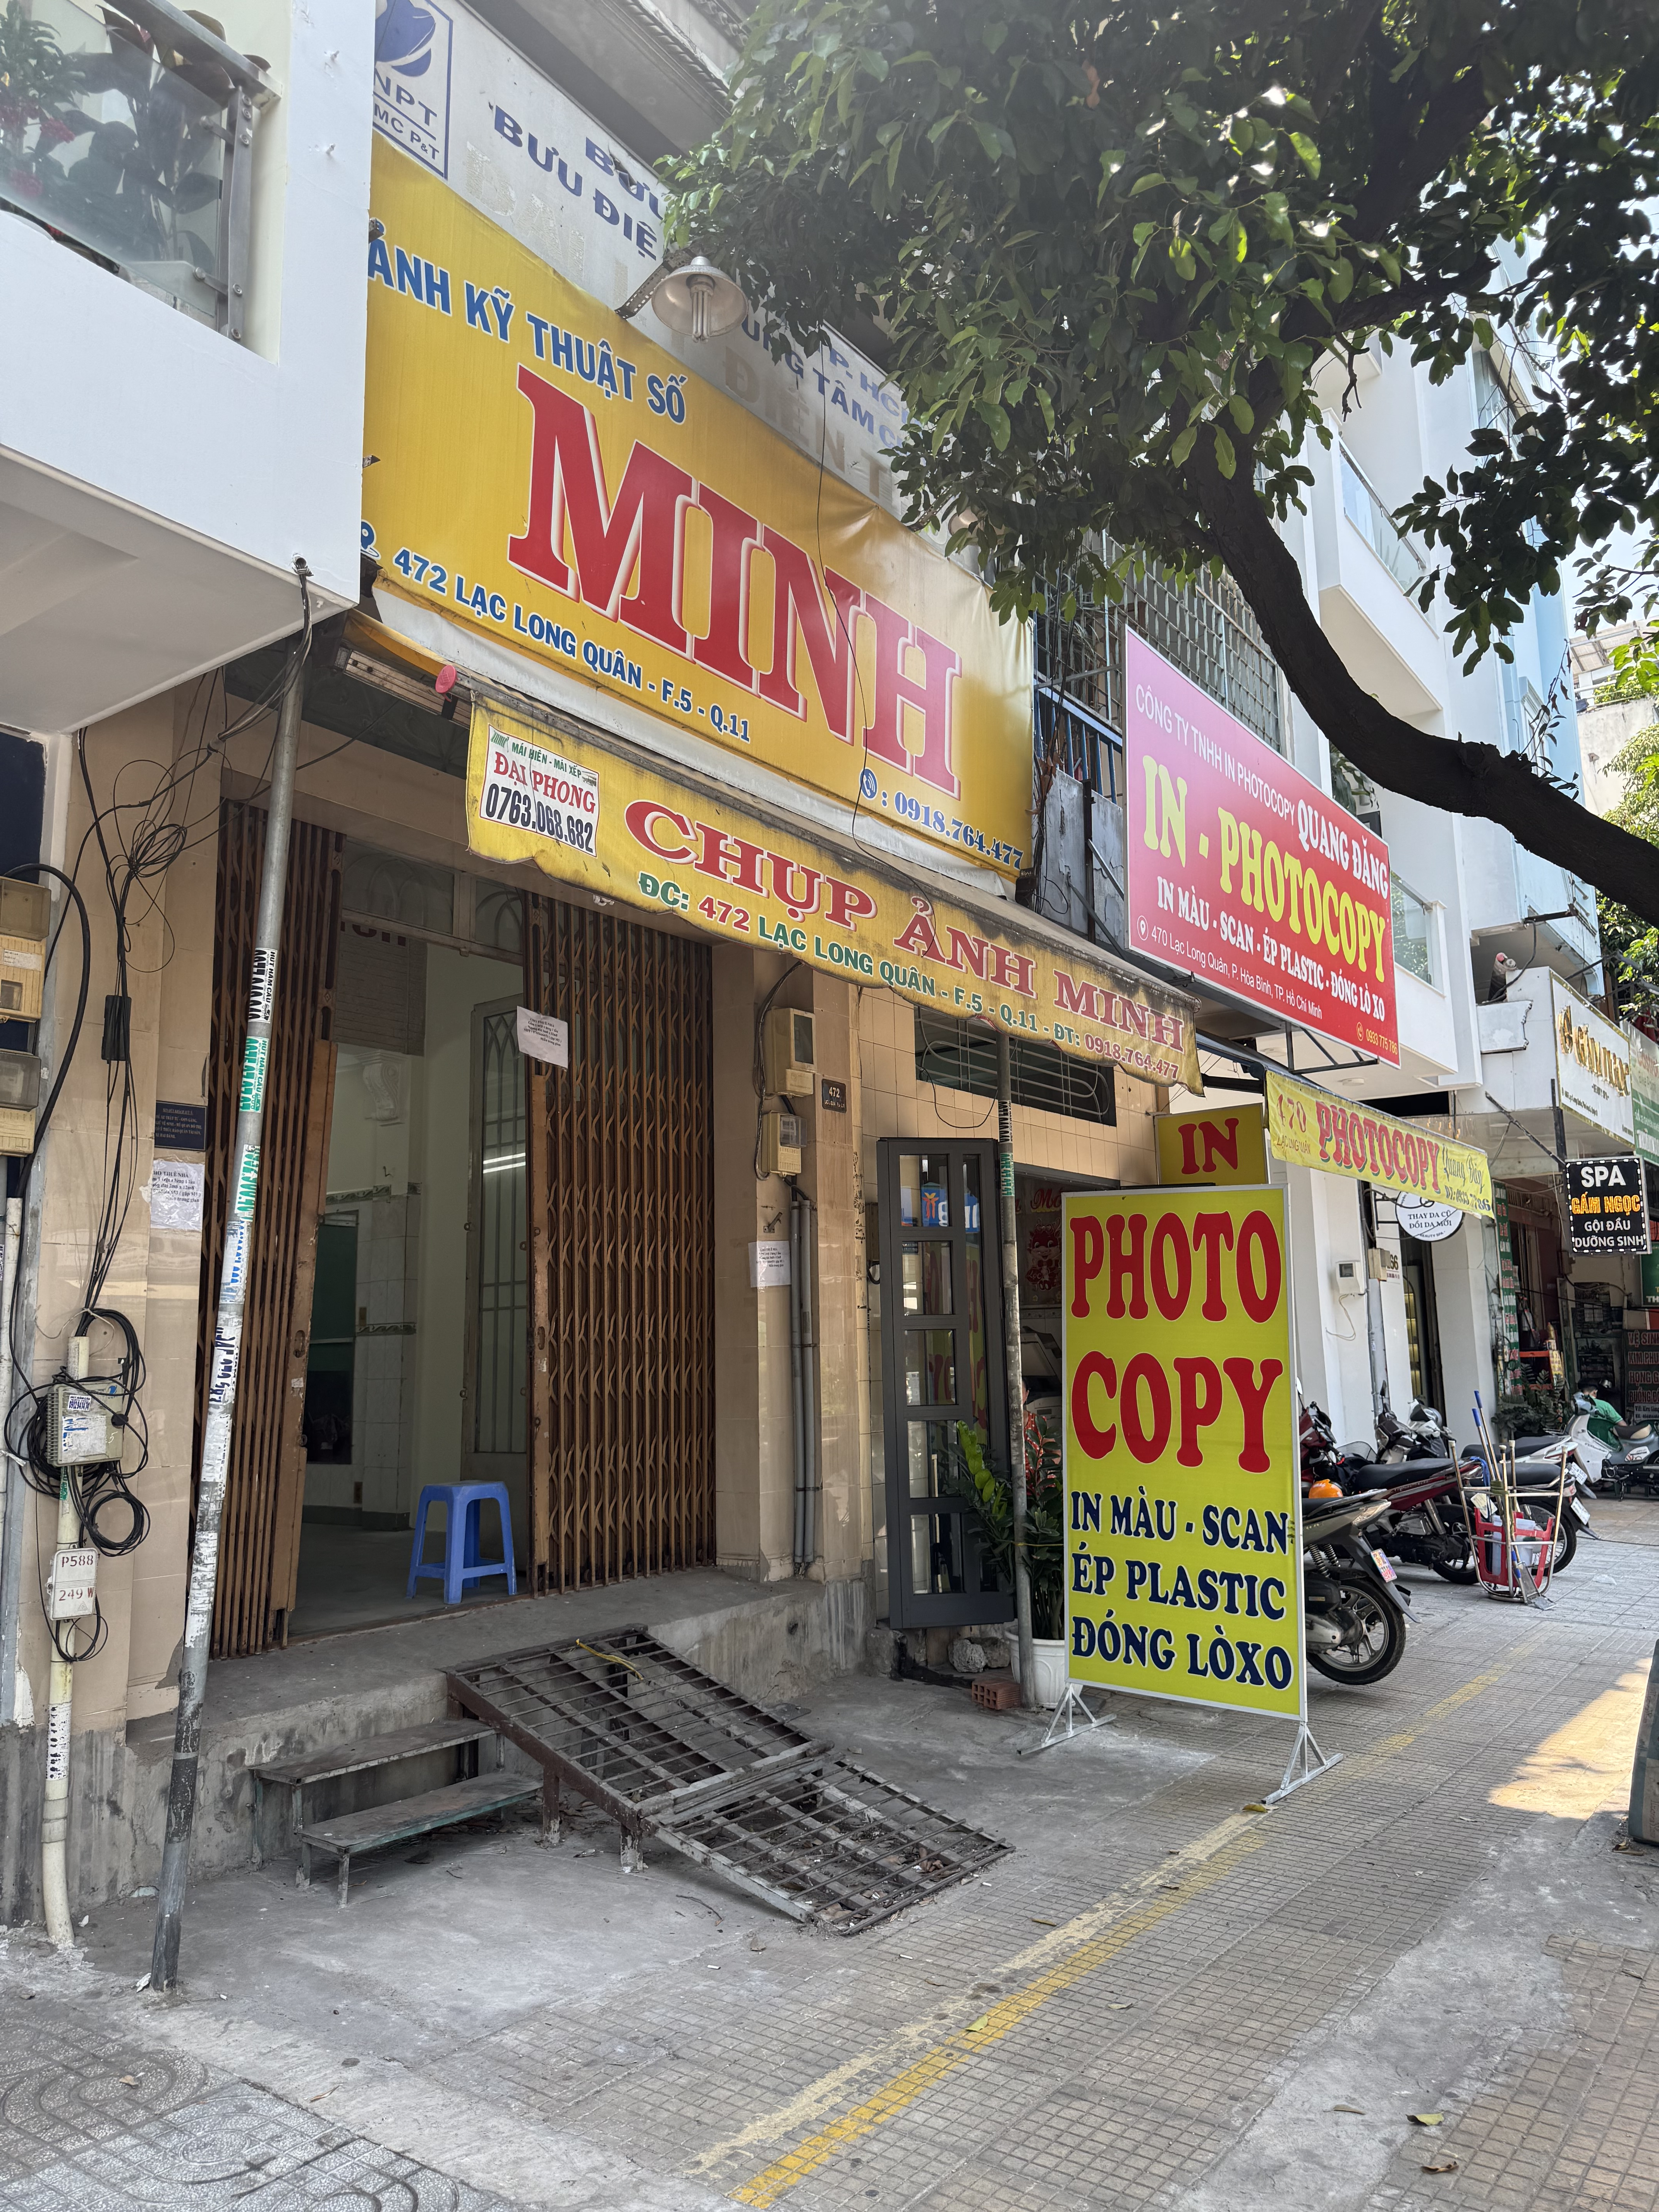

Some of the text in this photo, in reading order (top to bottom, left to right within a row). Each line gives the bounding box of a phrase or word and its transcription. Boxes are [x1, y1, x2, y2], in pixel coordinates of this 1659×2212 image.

[374, 68, 437, 127] NPT
[374, 105, 439, 160] MC P&T
[495, 105, 582, 197] BƯU
[593, 188, 657, 261] ĐIỆ
[464, 280, 515, 343] KỸ
[526, 311, 636, 401] THUẬT
[647, 374, 687, 424] SỐ
[813, 367, 874, 434] TÂM
[508, 364, 961, 800] MINH
[394, 547, 448, 596] 472
[455, 574, 507, 621] LẠC
[514, 604, 577, 658] LONG
[583, 640, 642, 691] QUÂN
[661, 678, 692, 713] F.5
[710, 703, 750, 743] Q.11
[494, 751, 595, 814] ĐẠI PHONG
[512, 741, 582, 778] MÁI HIÊN MÁI XẾP
[1135, 684, 1388, 899] CÔNG TY TNHH IN PHOTOCOPY QUANG ĐĂNG
[486, 783, 593, 853] 0763.068.682
[895, 792, 1022, 869] 0918.764.477
[1143, 755, 1187, 868] IN
[1218, 807, 1385, 982] PHOTOCOPY
[624, 800, 1185, 1054] CHỤP ẢNH MINH
[1158, 876, 1174, 911] IN
[1178, 885, 1209, 931] MÀU
[1220, 911, 1254, 955] SCAN
[1263, 928, 1276, 966] ÉP
[1281, 943, 1324, 988] PLASTIC
[1331, 968, 1357, 1008] ĐÓNG
[1360, 982, 1371, 1014] LÒ
[1372, 994, 1384, 1022] XO
[638, 871, 690, 912] ĐC:
[698, 895, 750, 933] 472
[758, 915, 807, 951] LẠC
[815, 936, 873, 975] LONG
[880, 960, 936, 997] QUÂN
[954, 987, 982, 1012] F.5
[1000, 1005, 1037, 1032] Q.11
[1054, 1022, 1080, 1047] ĐT:
[1085, 1034, 1178, 1079] 0918.764.477
[1151, 926, 1167, 945] 470
[1170, 935, 1185, 955] Lạc
[1187, 946, 1206, 968] Long
[1207, 951, 1230, 978] Quân,
[1232, 964, 1239, 981] P.
[1240, 967, 1254, 989] Hòa
[1274, 984, 1285, 1003] TP.
[1286, 987, 1295, 1007] Hồ
[1297, 995, 1307, 1013] Chí
[1308, 999, 1322, 1020] Minh
[1366, 1029, 1398, 1055] 0933 775 786
[829, 1087, 840, 1097] 472
[1178, 1118, 1239, 1175] IN
[1276, 1094, 1307, 1133] 470
[1316, 1100, 1441, 1194] PHOTOCOPY
[1581, 1166, 1626, 1187] SPA
[1409, 1221, 1422, 1229] ĐỔI
[1571, 1192, 1641, 1216] GẤM NGỌC
[1584, 1217, 1631, 1233] GỘI ĐẦU
[1069, 1209, 1281, 1323] PHOTO
[1387, 1254, 1398, 1270] 66
[1575, 1235, 1644, 1248] DƯỠNG SINH
[1071, 1350, 1283, 1473] COPY
[1070, 1491, 1102, 1532] IN
[1110, 1485, 1177, 1541] MÀU
[1202, 1504, 1290, 1554] SCAN
[59, 1589, 82, 1601] 249
[62, 1556, 93, 1567] P588
[1072, 1541, 1286, 1621] ÉP PLASTIC
[1072, 1609, 1176, 1671] ĐÓNG
